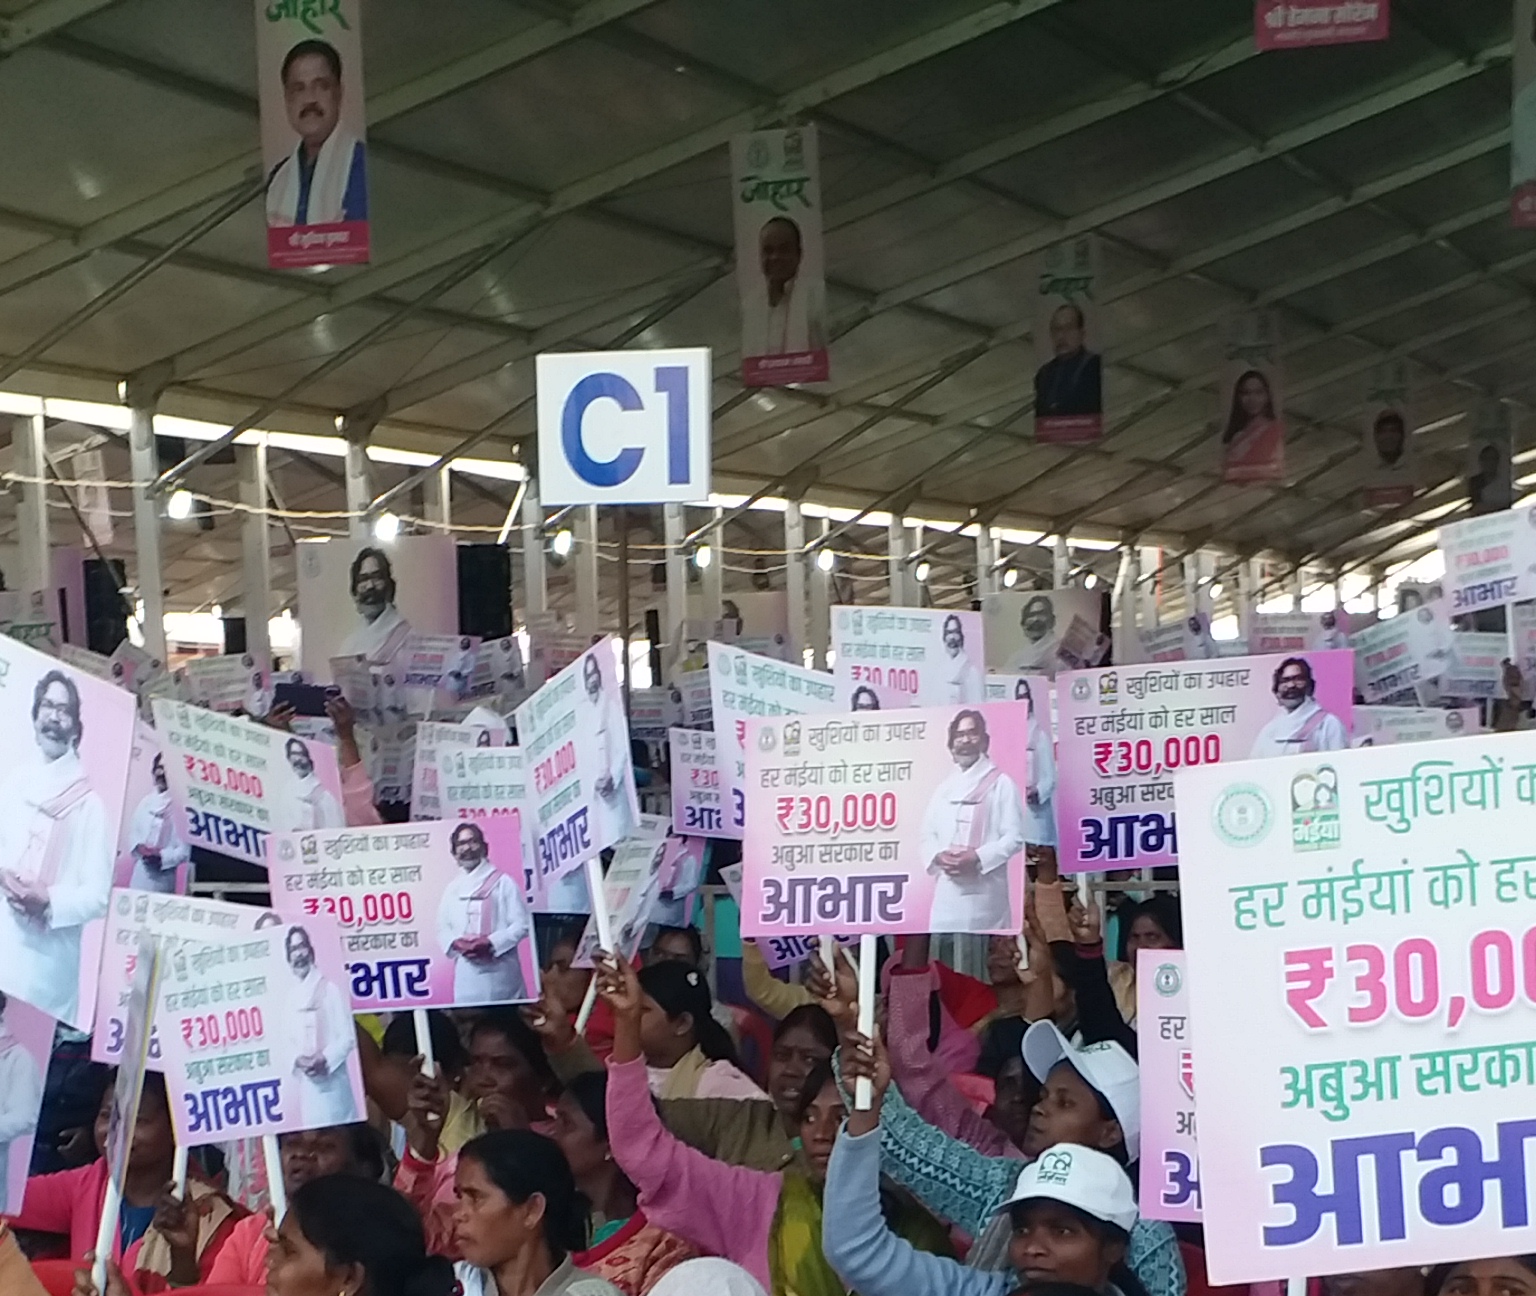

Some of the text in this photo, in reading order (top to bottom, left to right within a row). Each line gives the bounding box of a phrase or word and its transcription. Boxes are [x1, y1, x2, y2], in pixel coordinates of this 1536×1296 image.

[561, 365, 690, 489] C1
[1182, 672, 1202, 689] का
[1205, 668, 1250, 688] उपहार
[861, 724, 880, 742] का
[883, 720, 927, 741] उपहार
[1073, 716, 1097, 735] हर
[1147, 705, 1170, 729] को
[1172, 708, 1195, 727] हर
[1198, 705, 1236, 725] साल
[759, 768, 781, 788] हर
[827, 758, 849, 784] को
[851, 763, 873, 783] हर
[876, 760, 913, 782] साल
[1094, 734, 1220, 774] ₹30,000
[777, 792, 896, 834] ₹30,000
[1089, 785, 1136, 811] अबुआ
[1358, 755, 1502, 834] खुशियों
[771, 841, 899, 871] अबुआ सरकार का
[761, 874, 908, 923] आभार
[1228, 882, 1289, 931] हर
[1423, 848, 1480, 909] को
[179, 1005, 263, 1049] ₹30,000
[1158, 1016, 1187, 1040] हर
[183, 1077, 284, 1133] आभार
[1280, 1056, 1400, 1122] अबुआ
